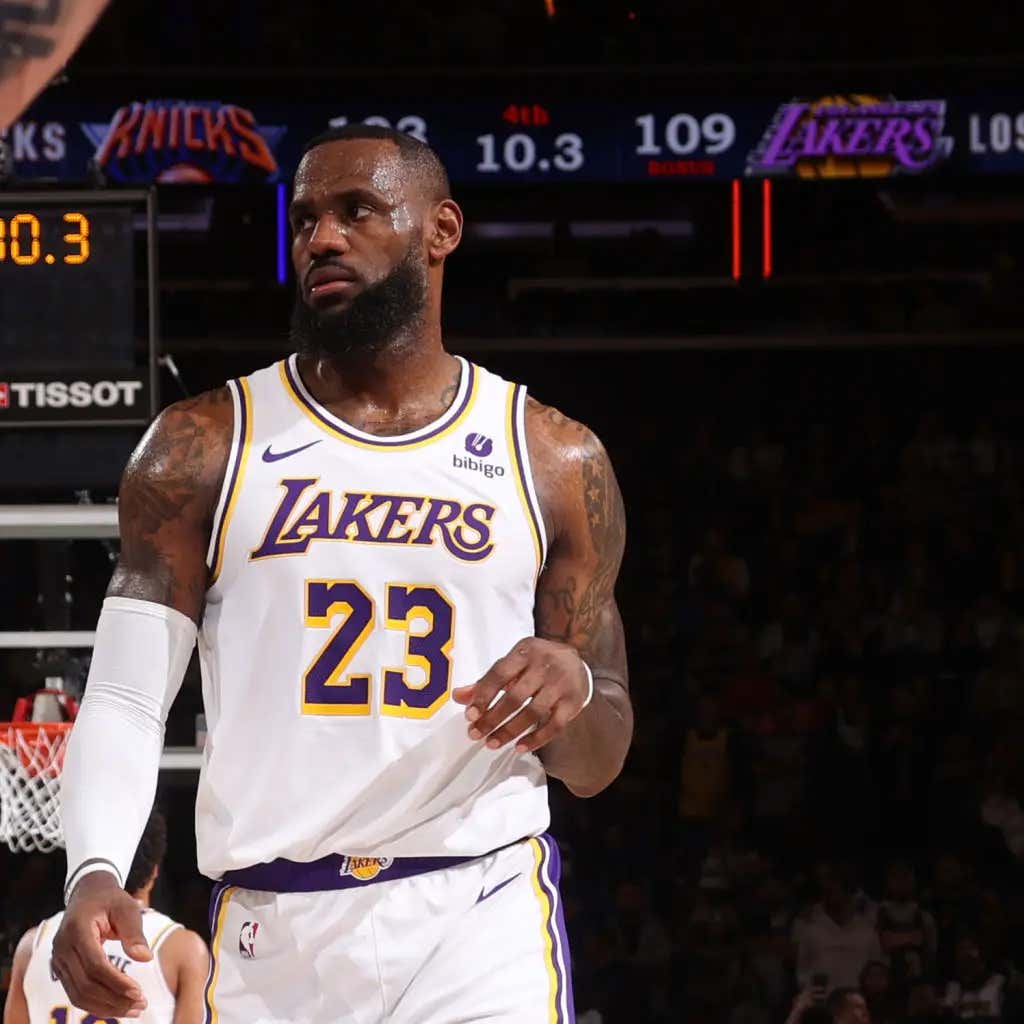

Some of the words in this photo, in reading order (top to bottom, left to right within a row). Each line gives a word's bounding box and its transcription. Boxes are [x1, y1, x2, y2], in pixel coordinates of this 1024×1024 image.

[503, 105, 549, 125] 4th
[635, 113, 736, 155] 109
[749, 100, 948, 172] LAKERS
[0, 121, 66, 160] KS
[95, 104, 277, 172] KNICKS
[476, 133, 584, 171] 10.3
[0, 213, 91, 265] 0.3
[10, 381, 142, 407] TISSOT
[452, 454, 505, 478] bibigo
[248, 476, 497, 563] LAKERS
[301, 578, 456, 720] 23
